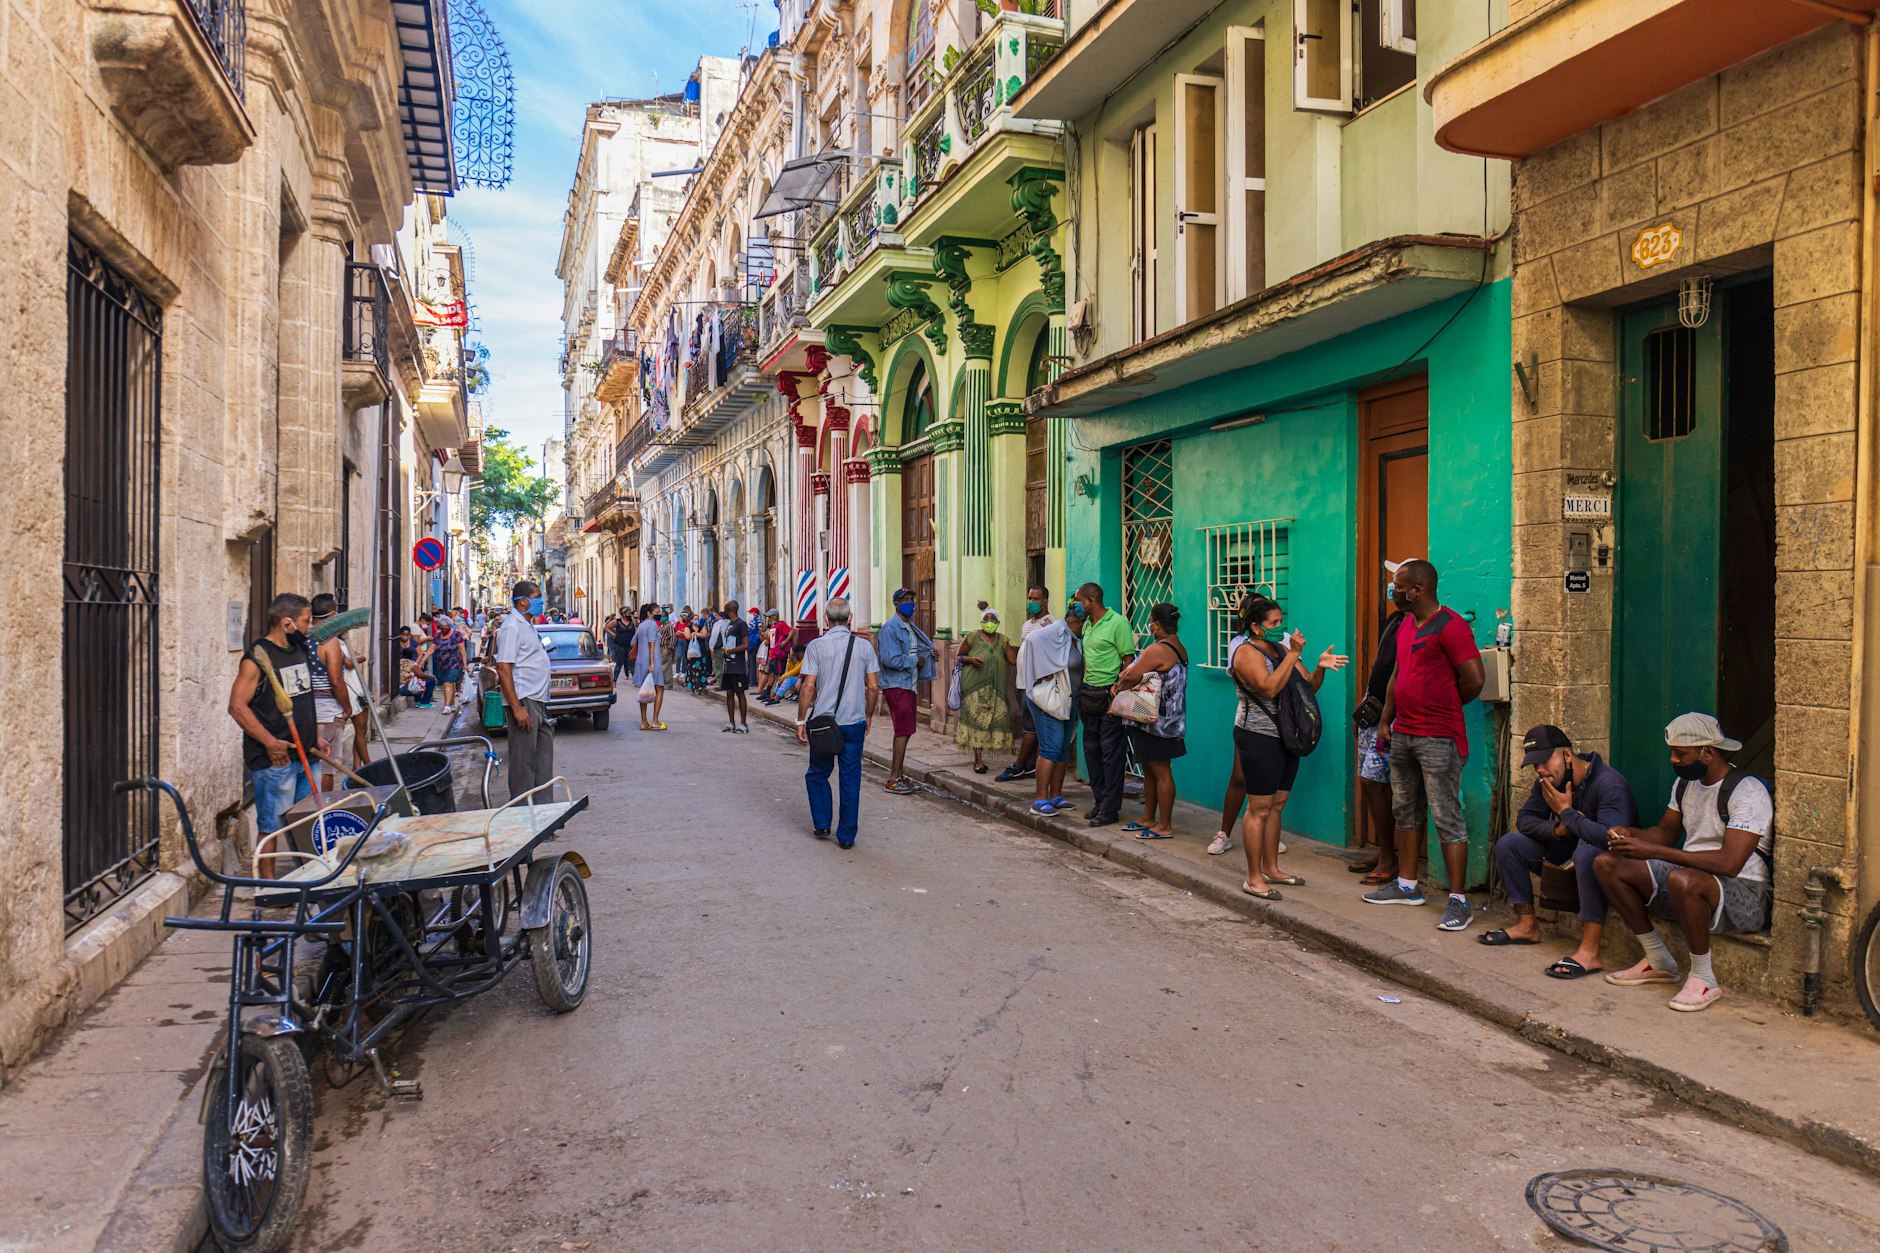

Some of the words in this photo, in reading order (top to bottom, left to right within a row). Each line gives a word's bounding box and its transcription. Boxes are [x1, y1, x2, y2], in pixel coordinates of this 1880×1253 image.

[1639, 230, 1672, 260] 623
[1566, 472, 1600, 485] Mercedes
[1566, 499, 1608, 513] MERCI
